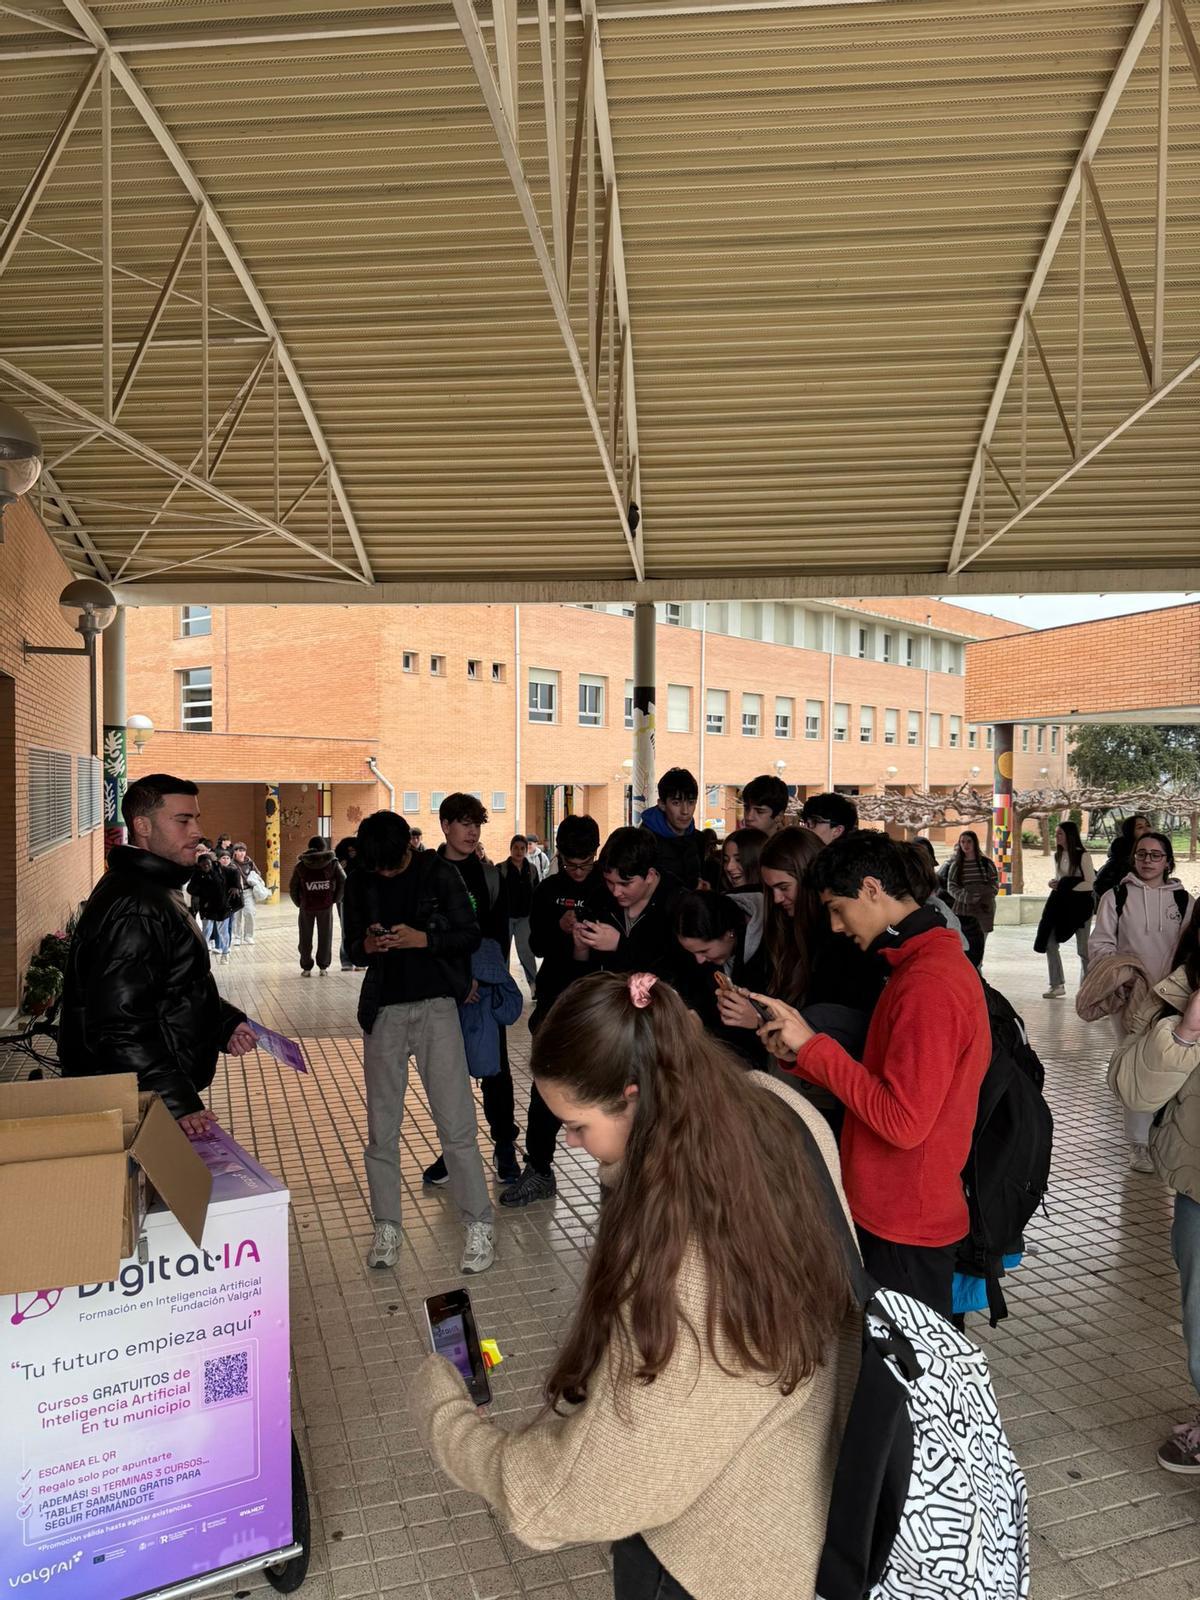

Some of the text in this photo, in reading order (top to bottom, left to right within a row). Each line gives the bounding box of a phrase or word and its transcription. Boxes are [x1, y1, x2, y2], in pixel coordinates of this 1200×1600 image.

[305, 880, 330, 891] VANS
[79, 1276, 262, 1322] Formación en Inteligencia Artificial
[171, 1296, 225, 1314] Fundación
[52, 1348, 119, 1373] futuro
[125, 1328, 207, 1356] empieza
[37, 1369, 191, 1414] Cursos GRATUITOS de
[42, 1382, 191, 1429] Inteligencia Artificial
[82, 1399, 191, 1434] En tu municipio
[38, 1450, 117, 1479] ESCANEA EL QR
[38, 1452, 173, 1495] Regalo solo por apuntarte
[91, 1485, 100, 1495] SI
[103, 1470, 153, 1492] TERMINAS
[155, 1468, 162, 1478] 3
[86, 1486, 137, 1508] SAMSUNG
[139, 1476, 174, 1493] GRATIS
[176, 1468, 201, 1482] PARA
[45, 1491, 155, 1531] SEGUIR FORMÁNDOTE
[105, 1521, 127, 1533] hasta
